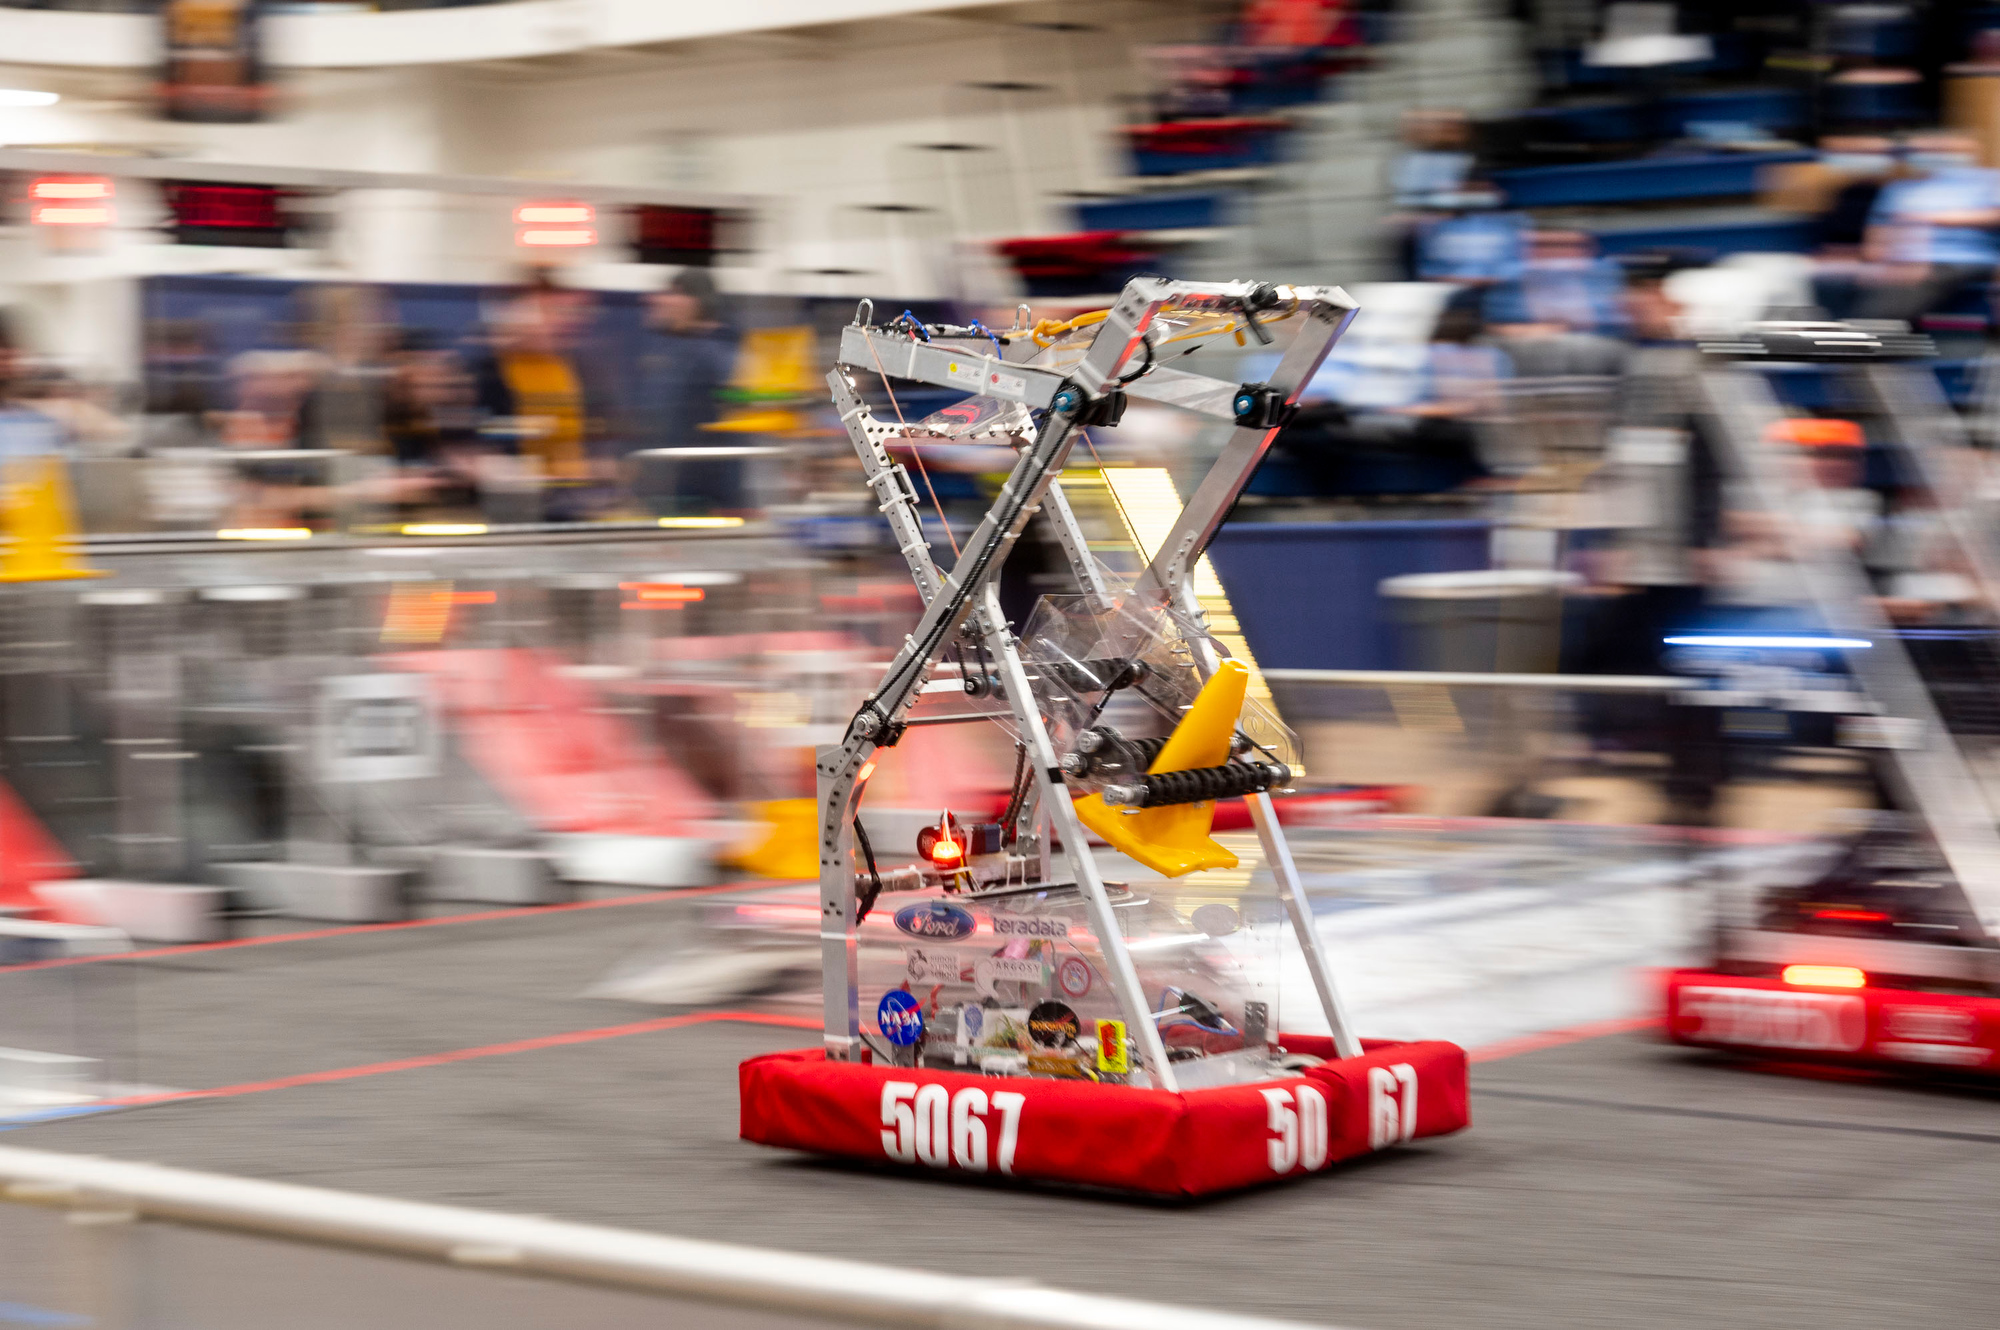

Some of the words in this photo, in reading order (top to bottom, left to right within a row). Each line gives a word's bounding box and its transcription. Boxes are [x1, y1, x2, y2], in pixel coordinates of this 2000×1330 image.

[910, 908, 960, 938] Ford
[994, 916, 1068, 938] teradata
[996, 961, 1040, 974] ARGOSY
[881, 1009, 921, 1027] NASA
[881, 1080, 1026, 1175] 5067
[1263, 1086, 1328, 1174] 50
[1368, 1063, 1418, 1151] 67
